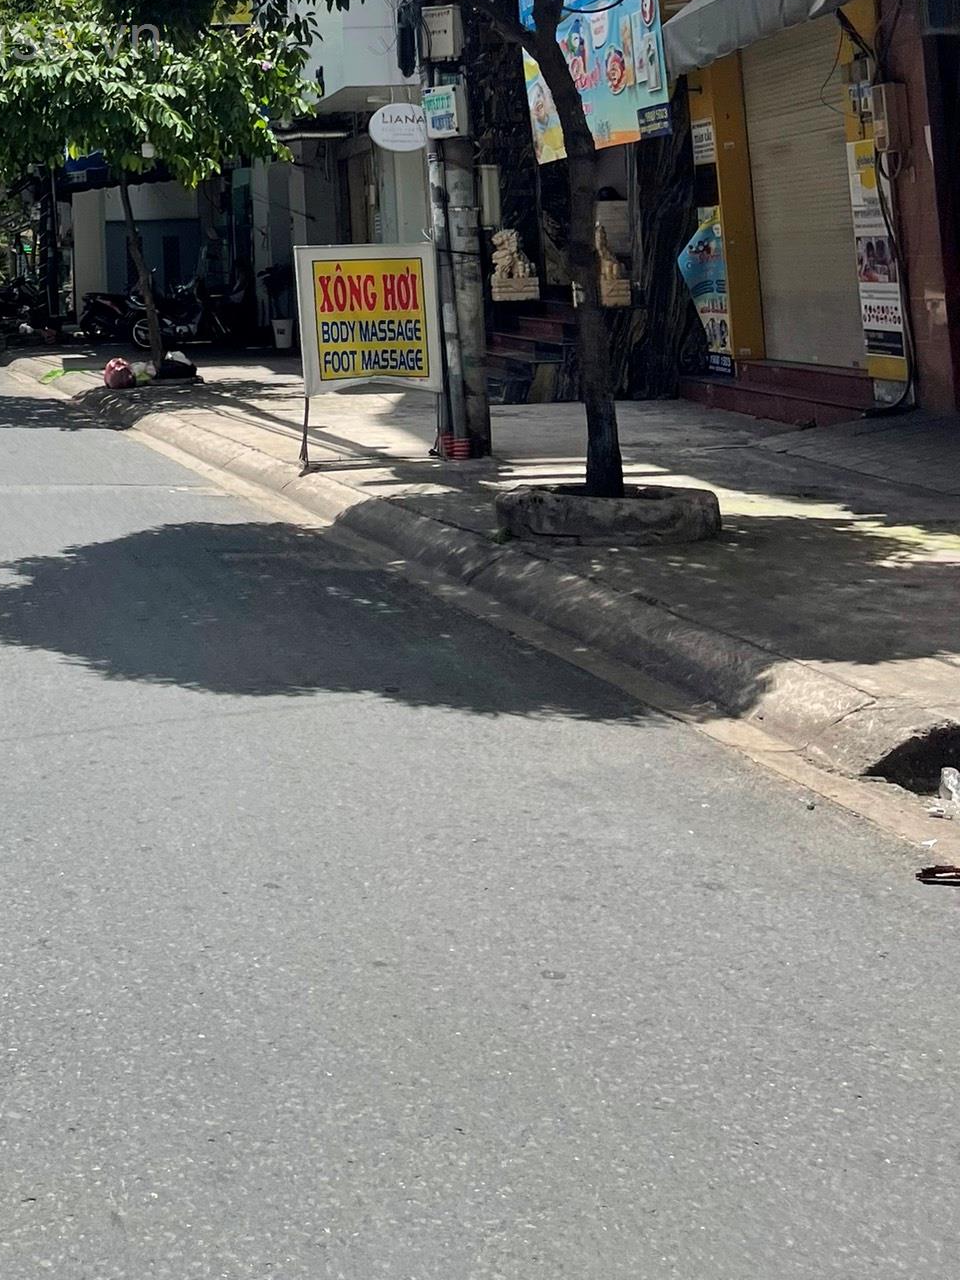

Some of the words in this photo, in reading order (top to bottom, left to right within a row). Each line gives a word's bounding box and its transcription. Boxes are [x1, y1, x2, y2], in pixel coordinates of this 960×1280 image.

[381, 112, 426, 124] LIANA
[318, 263, 378, 313] XÔNG
[382, 266, 419, 312] HƠI
[321, 321, 356, 344] BODY
[359, 319, 422, 342] MASSAGE
[324, 350, 357, 373] FOOT
[361, 348, 424, 371] MASSAGE
